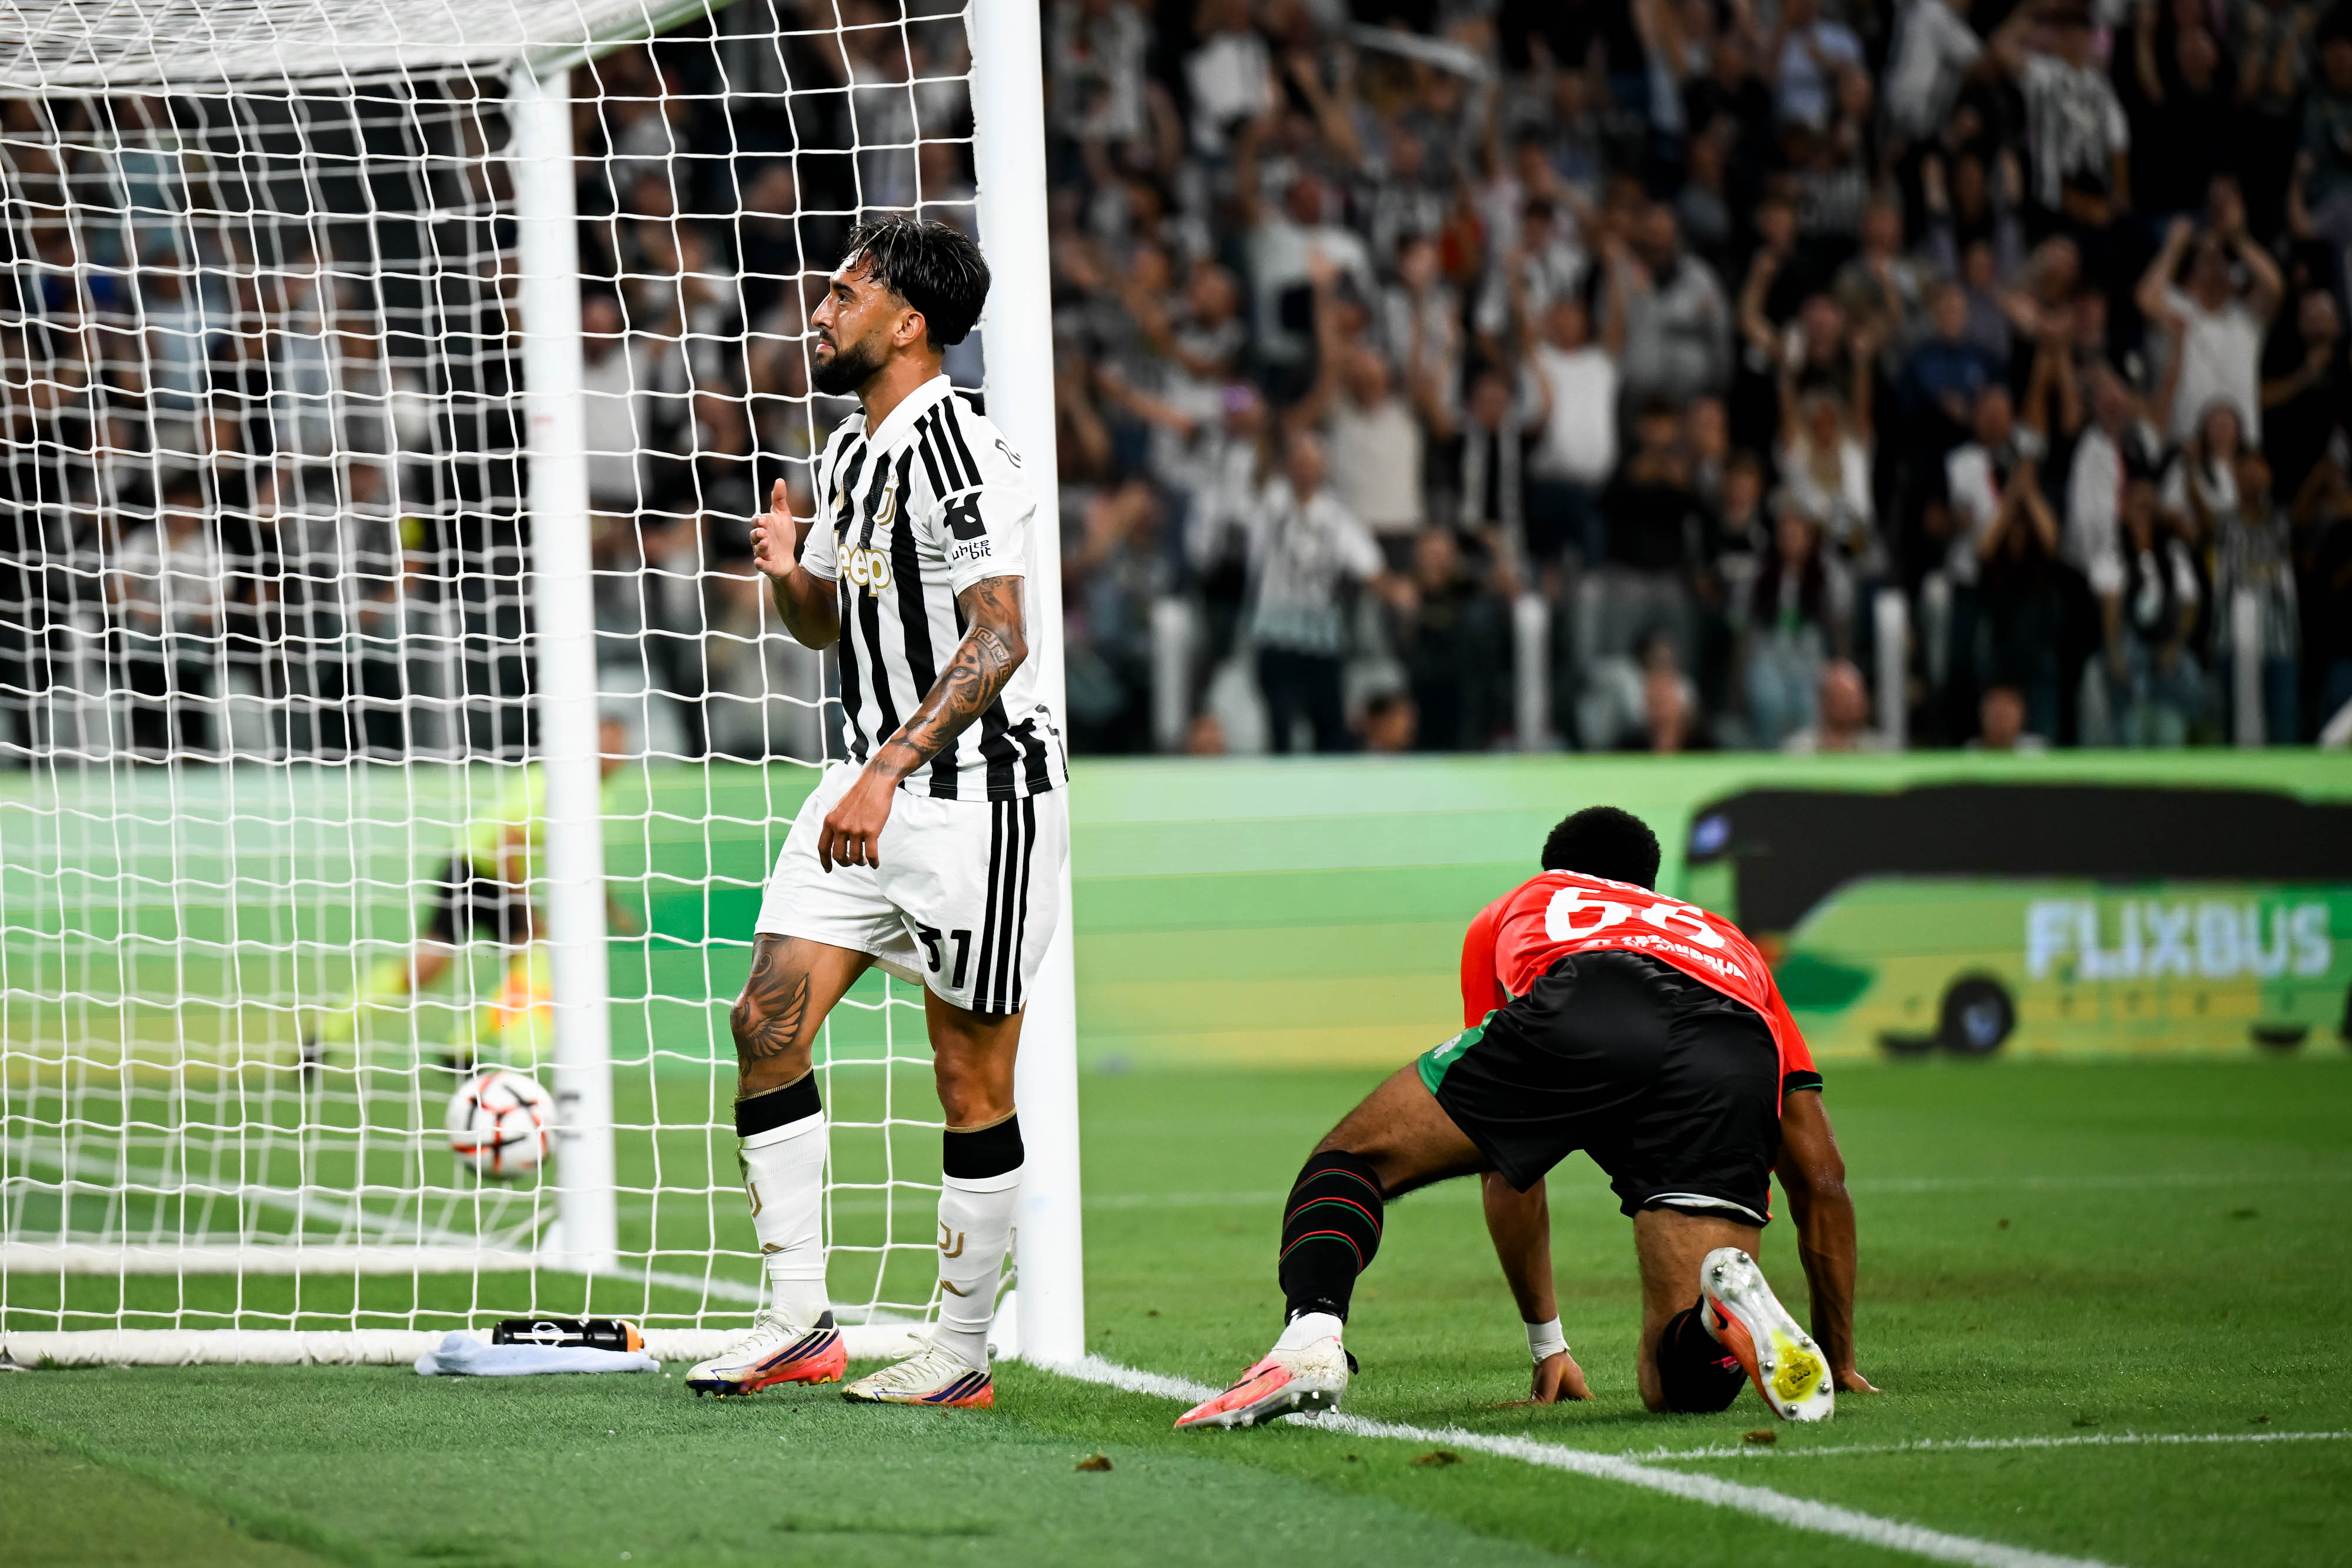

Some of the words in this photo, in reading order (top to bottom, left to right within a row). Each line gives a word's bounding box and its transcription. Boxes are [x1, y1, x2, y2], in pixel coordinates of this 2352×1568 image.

[1545, 887, 1725, 949] 66
[2026, 900, 2332, 980] FLIXBUS
[915, 920, 972, 989] 31
